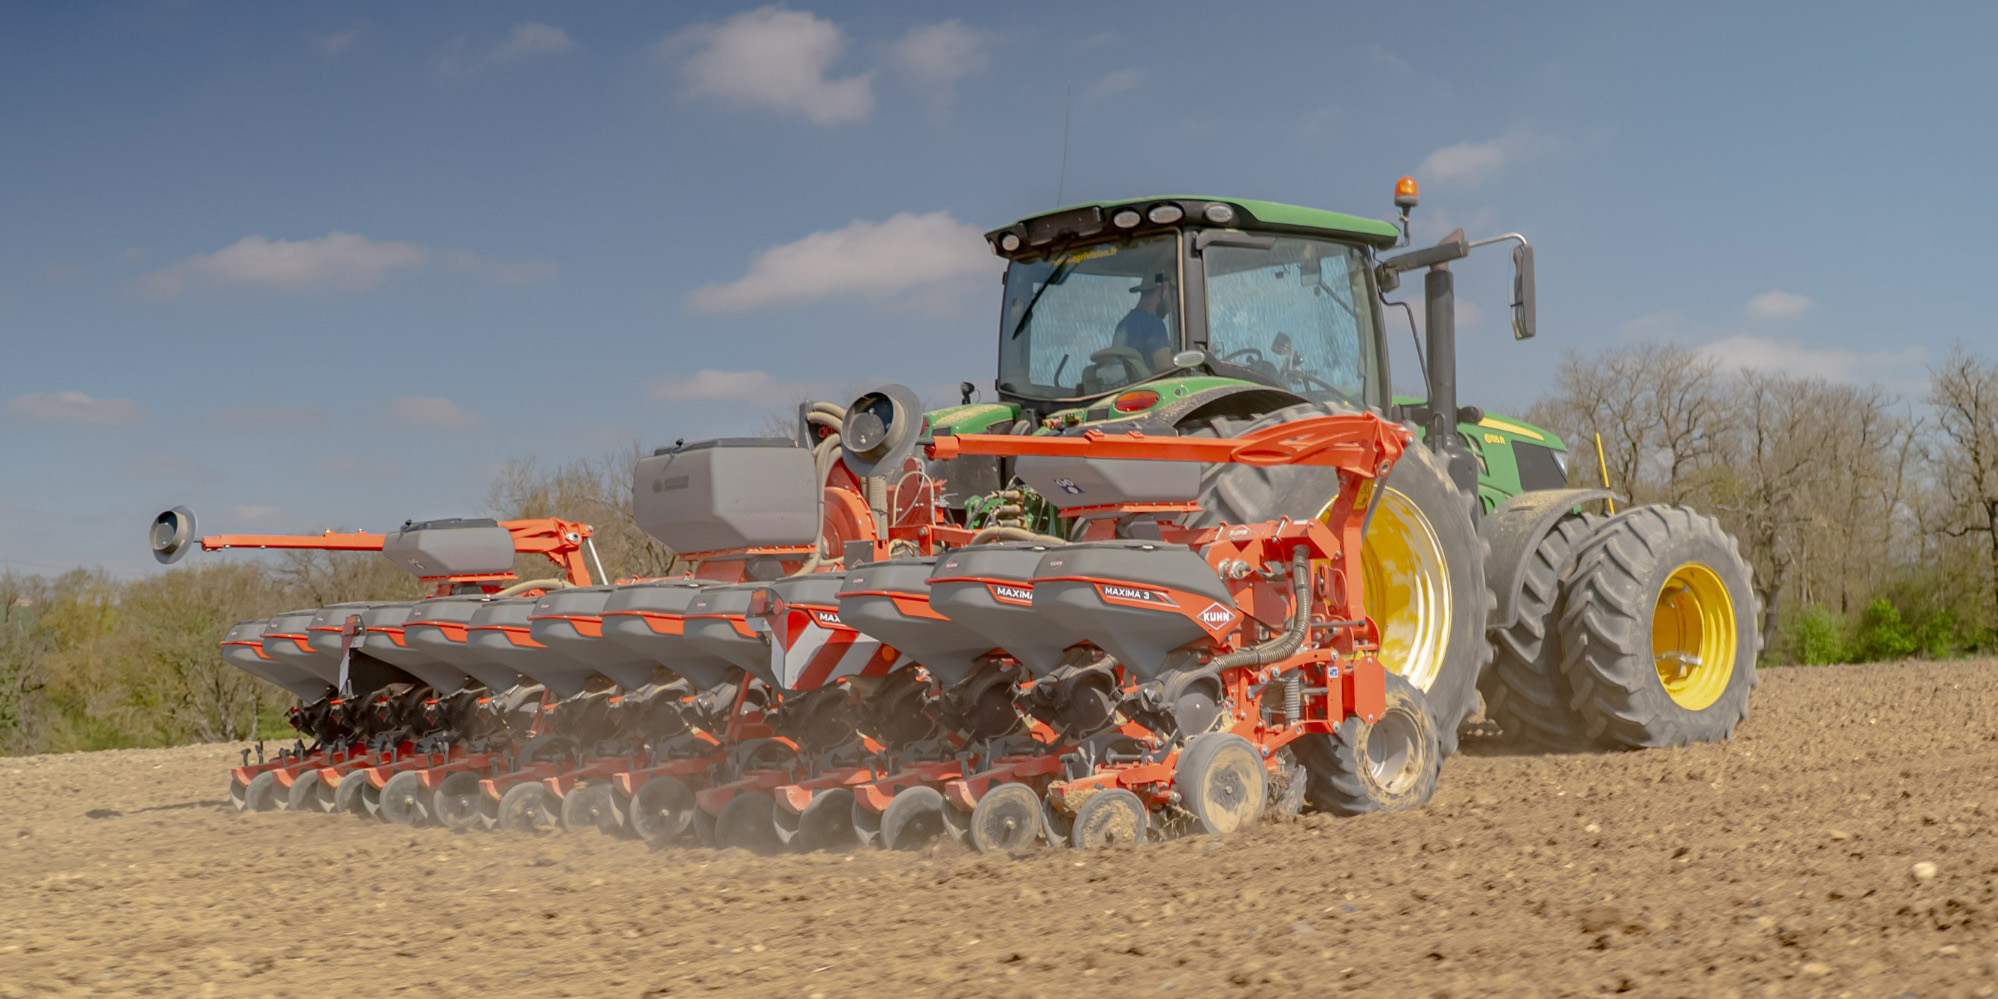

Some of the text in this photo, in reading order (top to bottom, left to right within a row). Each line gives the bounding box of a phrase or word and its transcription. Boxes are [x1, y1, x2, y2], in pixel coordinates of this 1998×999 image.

[1105, 586, 1150, 600] MAXIMA 3
[1203, 611, 1230, 622] KUHN
